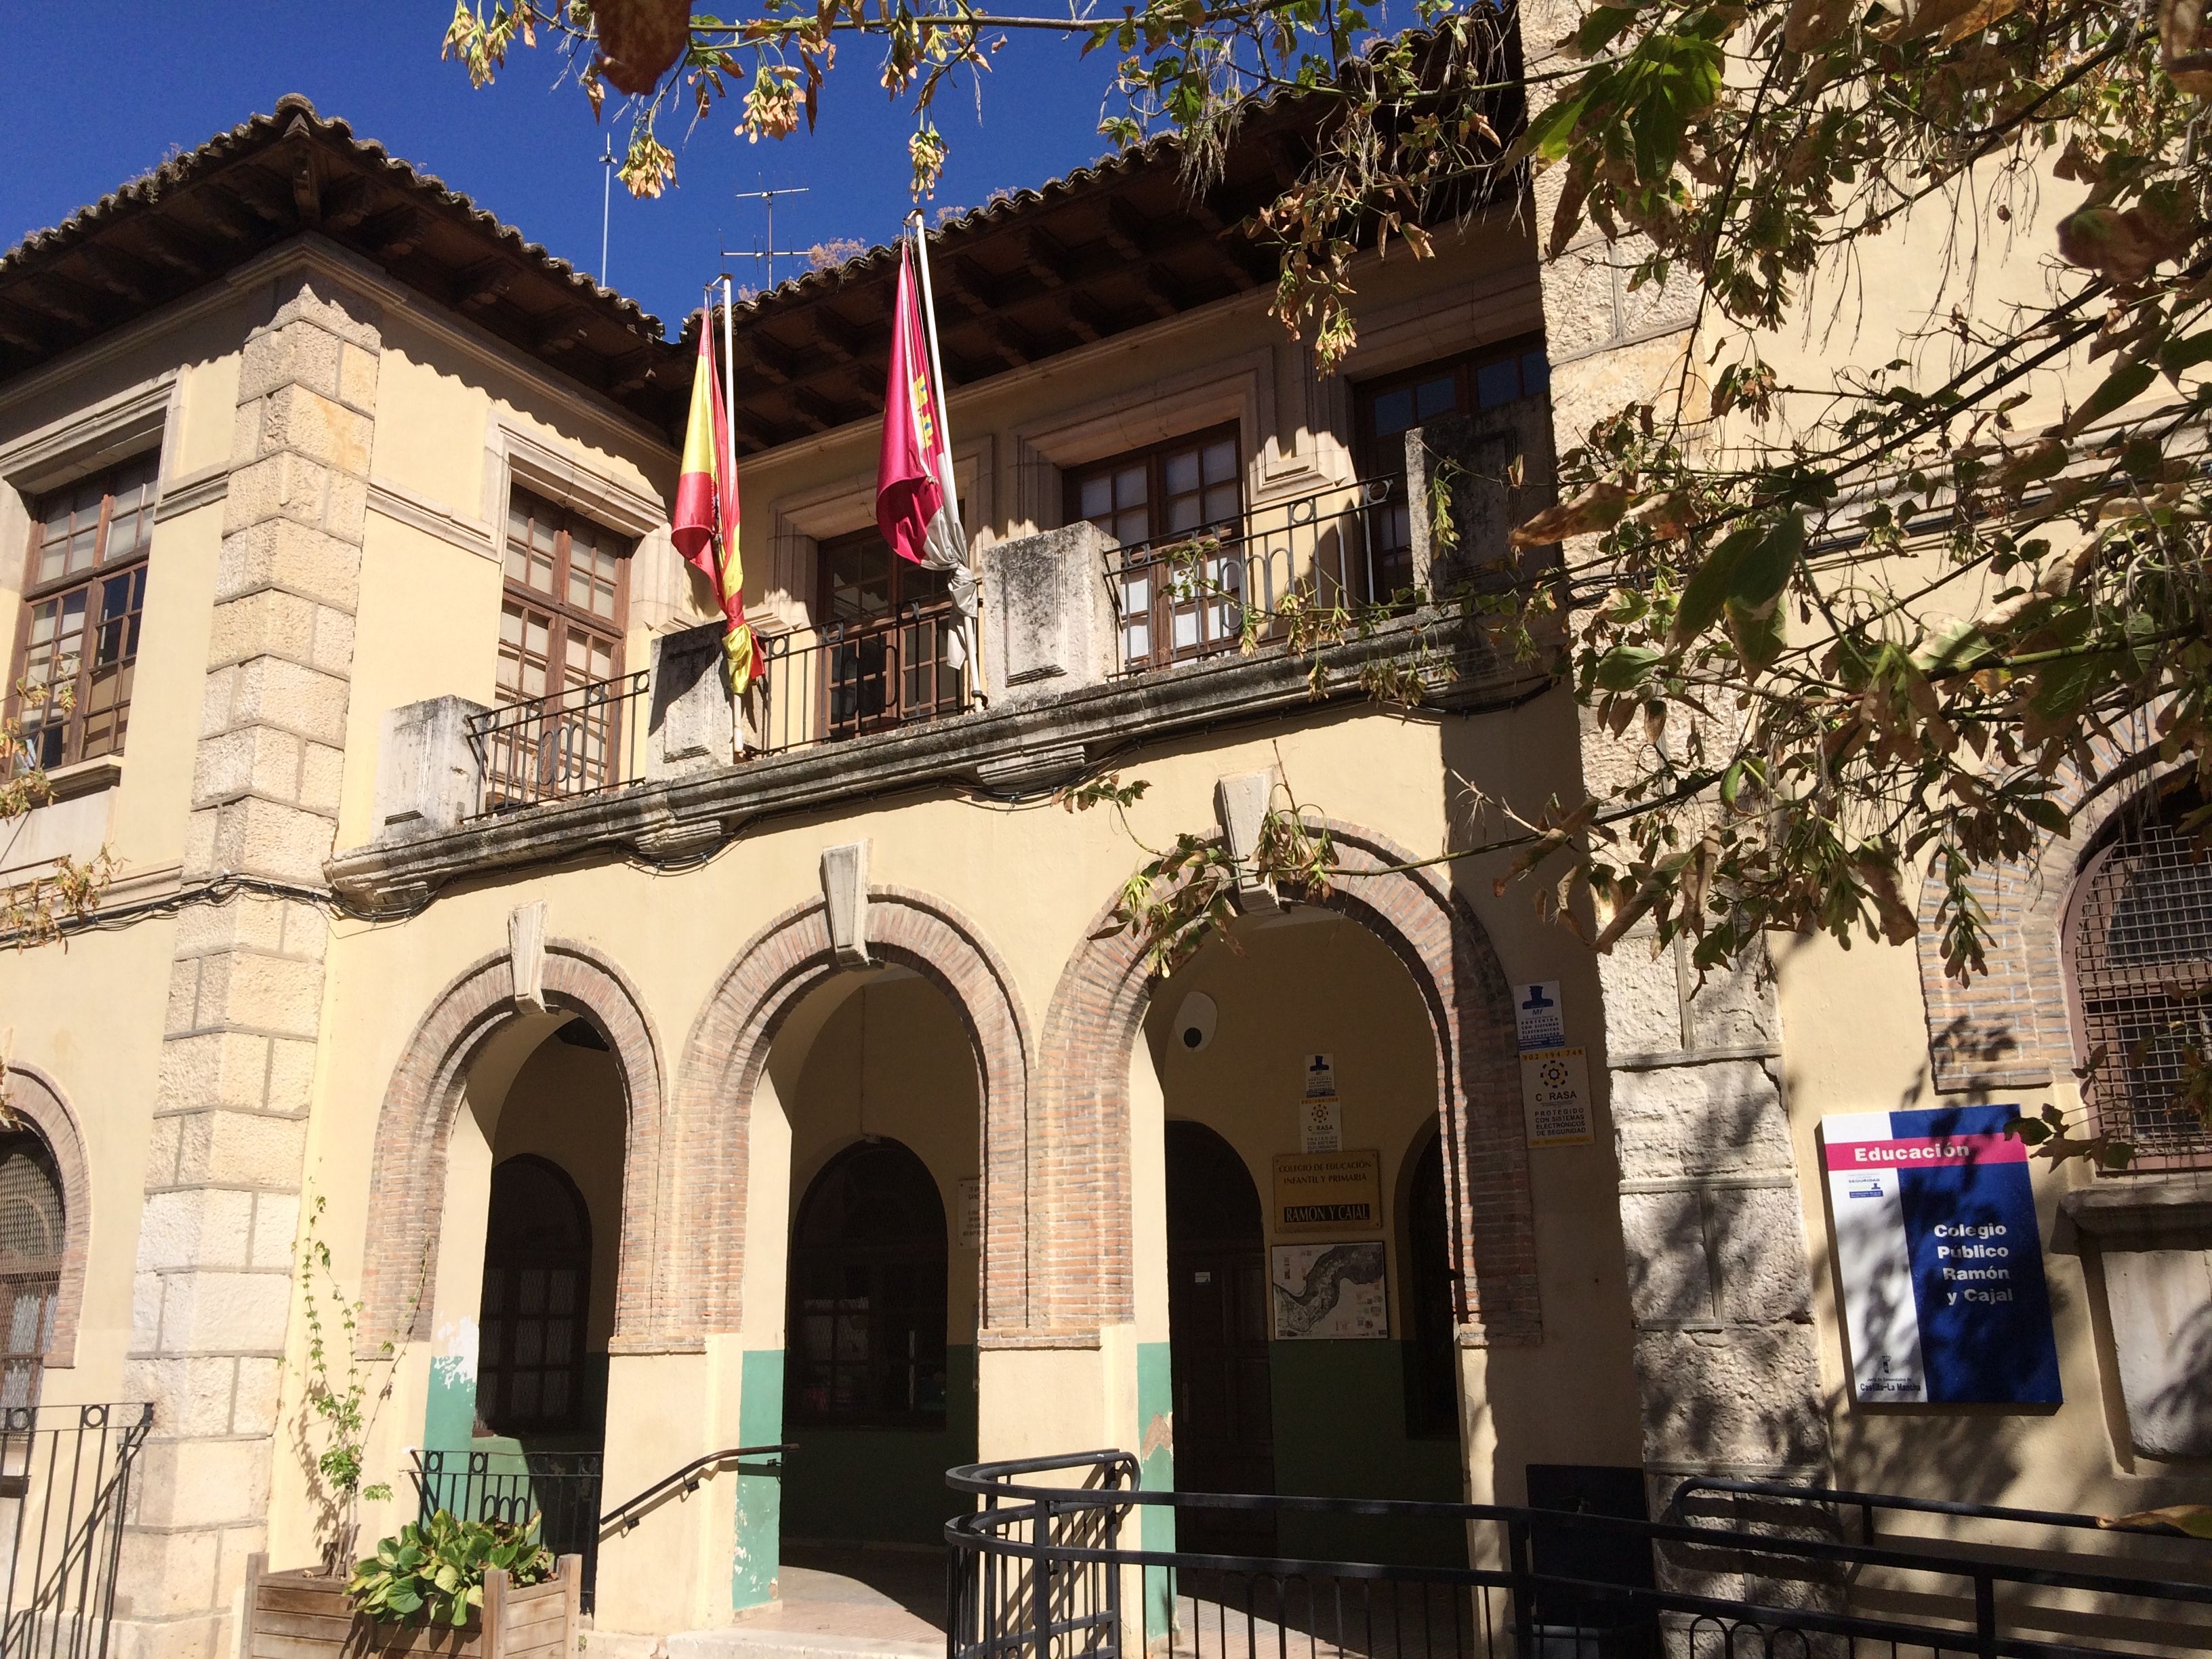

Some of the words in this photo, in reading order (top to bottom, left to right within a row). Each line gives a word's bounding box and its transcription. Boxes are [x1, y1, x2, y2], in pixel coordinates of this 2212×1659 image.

[1535, 1107, 1584, 1117] PROTEGIDO
[1548, 1127, 1586, 1136] SEGURIDAD
[1854, 1143, 1969, 1162] Educación
[1279, 1164, 1312, 1172] COLEGIO
[1326, 1160, 1371, 1170] EDUCACIÓN
[1284, 1176, 1319, 1184] INFANTIL
[1328, 1173, 1367, 1182] PRIMARIA
[1329, 1206, 1335, 1220] Y
[1338, 1205, 1368, 1220] CAJAL
[1934, 1223, 2007, 1240] Colegio
[1938, 1245, 2009, 1258] Público
[1943, 1266, 2010, 1280] Ramón
[1947, 1292, 1957, 1305] y
[1964, 1288, 2013, 1305] Cajal
[1860, 1382, 1896, 1391] Castilla-La
